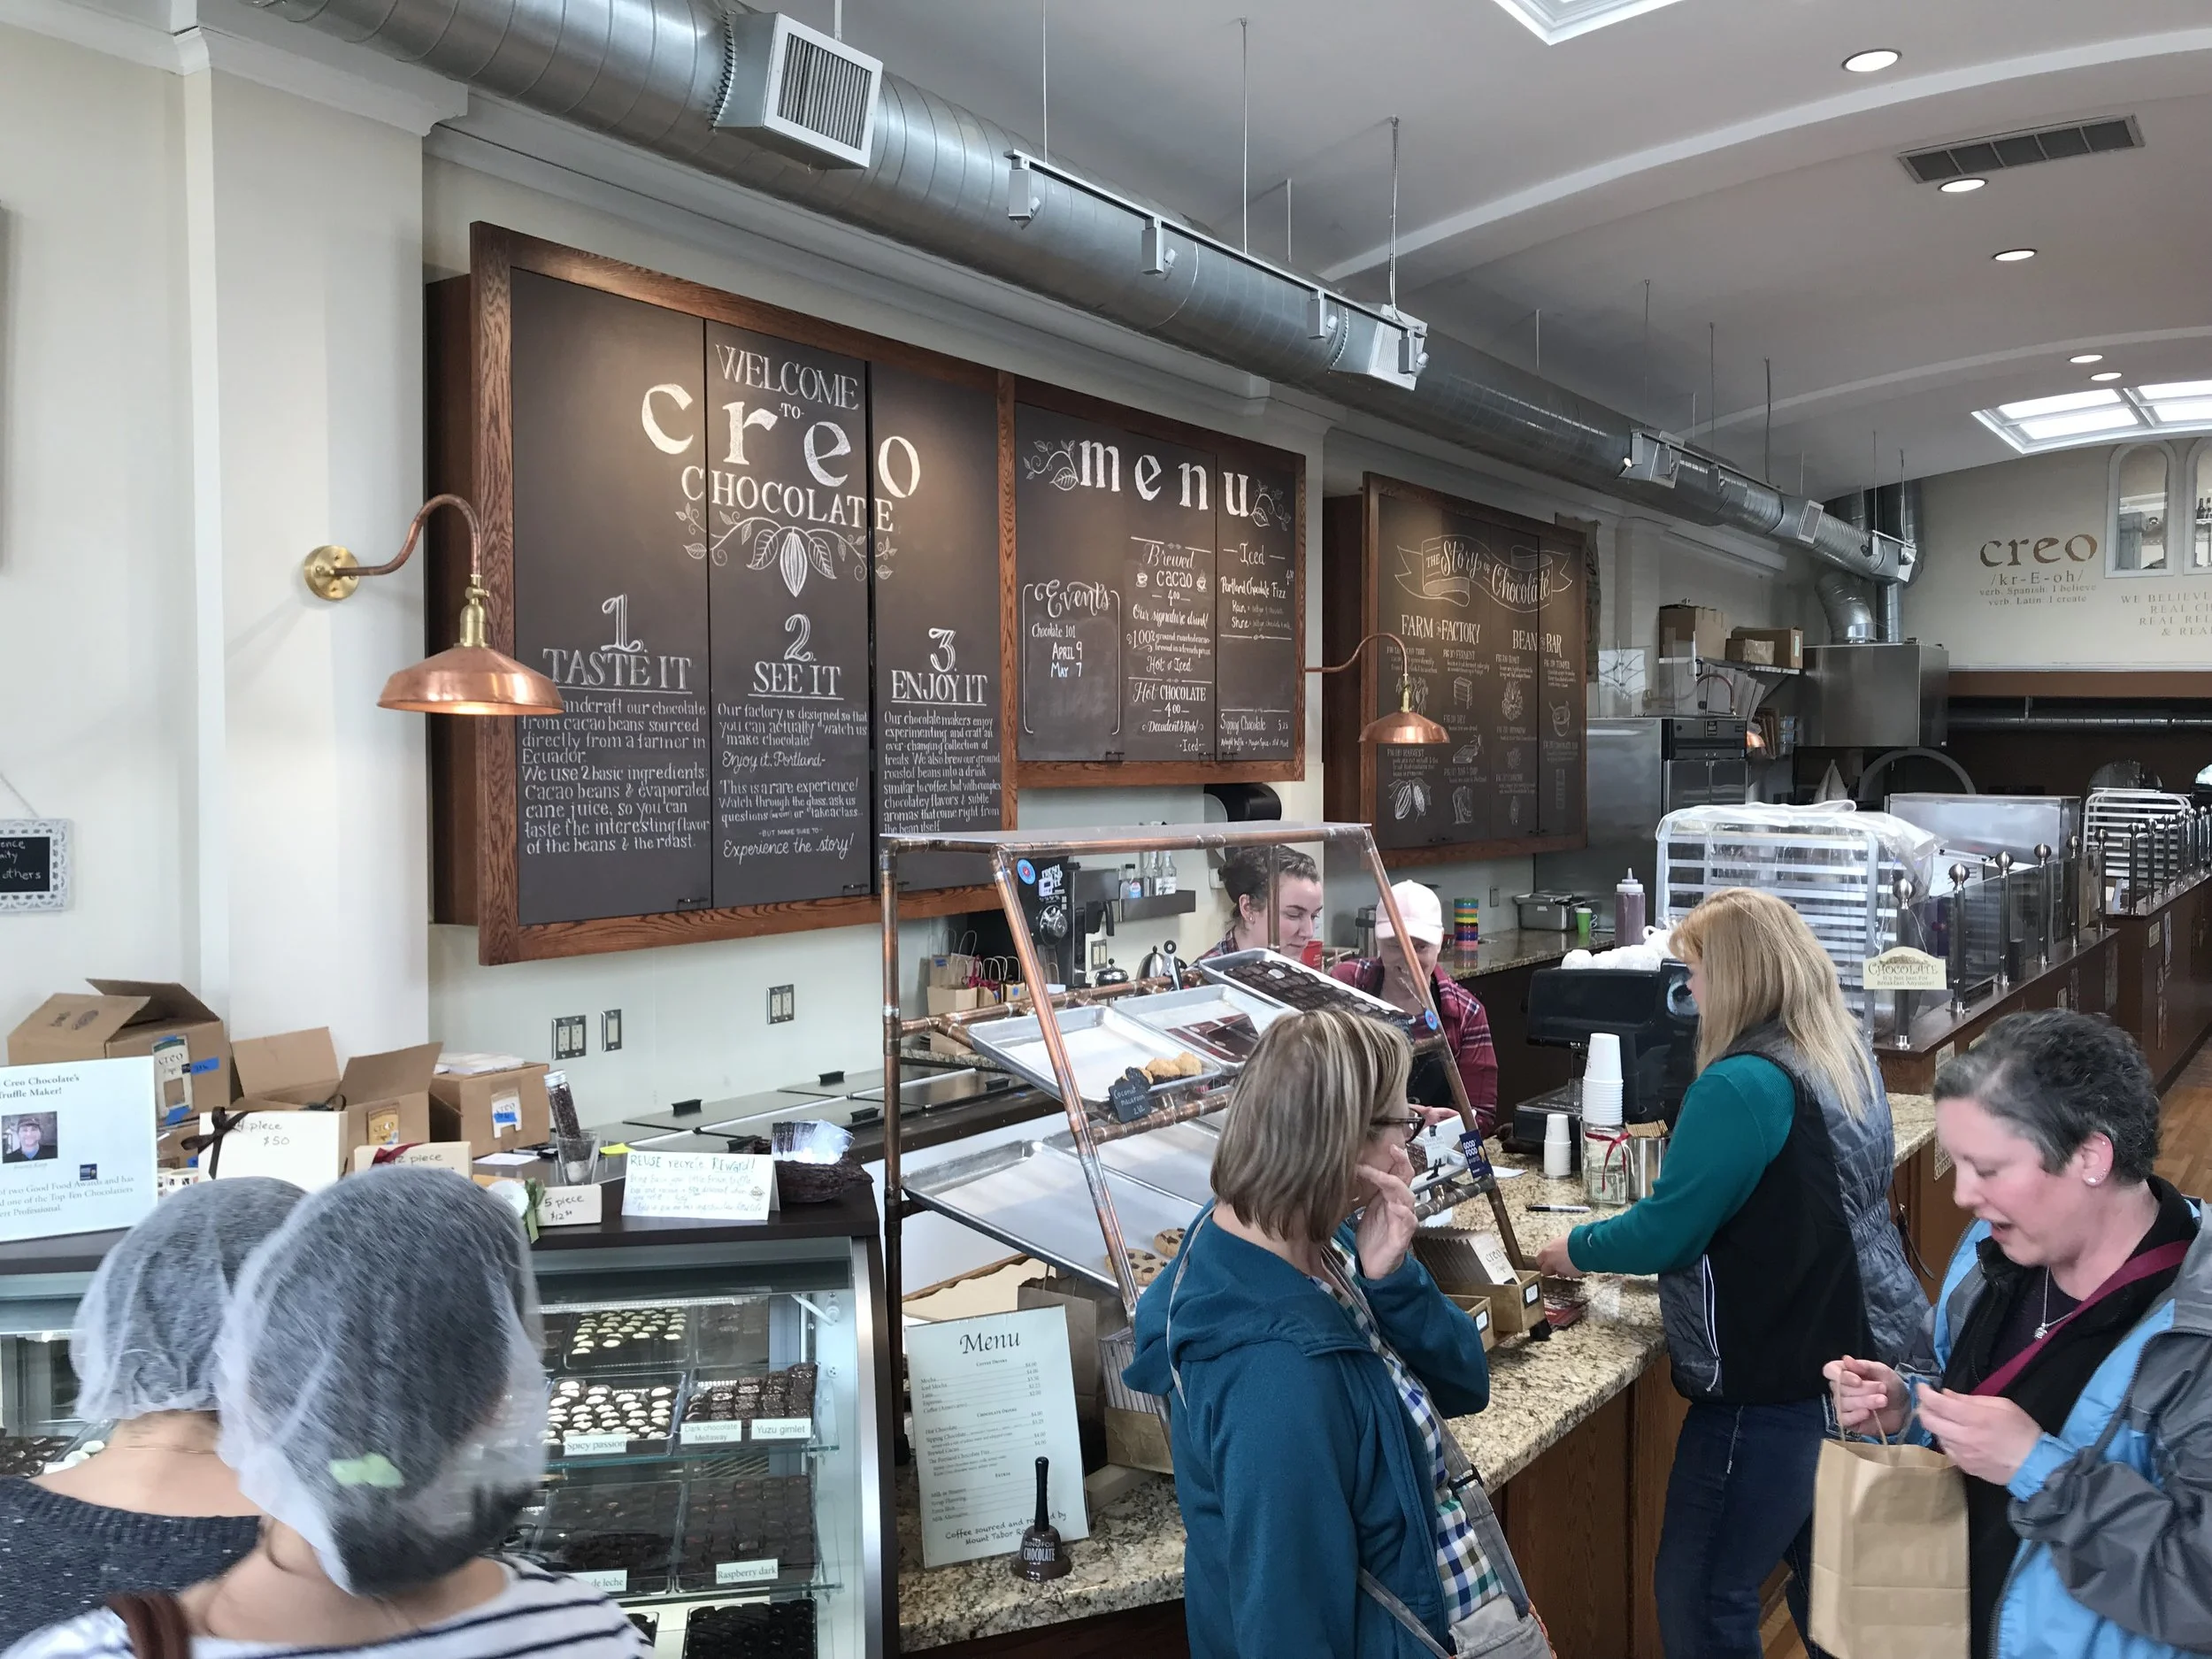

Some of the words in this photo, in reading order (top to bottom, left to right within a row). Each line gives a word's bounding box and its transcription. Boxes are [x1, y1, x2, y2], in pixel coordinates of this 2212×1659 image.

[716, 344, 859, 411] WELCOME
[641, 383, 921, 498] creo
[1079, 440, 1249, 517] menu
[680, 465, 894, 533] CHOCOLATE
[1146, 543, 1195, 570] Brewed
[1239, 541, 1266, 566] Iced
[1979, 534, 2098, 567] creo
[1425, 554, 1440, 569] THE
[1440, 540, 1483, 578] Story
[1491, 563, 1551, 605] Chocolate
[1220, 575, 1247, 595] Portland
[1247, 576, 1270, 598] Chocolate
[2058, 582, 2097, 593] believe
[2056, 594, 2087, 603] create
[1133, 603, 1149, 621] Our
[1150, 609, 1186, 627] signature
[1032, 622, 1064, 638] Chocolate
[1065, 625, 1076, 638] 101
[1401, 613, 1433, 640] FARM
[1441, 618, 1481, 645] FACTORY
[1512, 629, 1538, 652] BEAN
[1546, 632, 1563, 659] BAR
[1076, 641, 1083, 660] 9
[542, 648, 651, 687] TASTE
[657, 656, 693, 689] IT
[1076, 662, 1083, 678] 7
[1146, 656, 1165, 674] Hot
[1174, 657, 1194, 672] Iced
[753, 661, 803, 694] SEE
[810, 664, 841, 695] IT
[891, 670, 960, 702] ENJOY
[964, 675, 988, 703] IT
[1133, 681, 1158, 703] Hot
[1160, 684, 1206, 701] CHOCOLATE
[651, 700, 707, 716] chocolate
[718, 703, 742, 717] Our
[745, 703, 783, 724] factory
[798, 707, 840, 727] designed
[521, 715, 560, 731] from
[564, 718, 605, 731] cacao
[608, 716, 644, 732] beans
[649, 718, 700, 733] sourced
[769, 721, 814, 740] actually
[1220, 712, 1239, 735] Sipping
[1240, 715, 1266, 731] Chocolate
[521, 732, 580, 749] directly
[586, 732, 622, 749] from
[637, 733, 689, 749] farmer
[726, 734, 759, 747] make
[885, 726, 948, 742] experimenting
[722, 750, 758, 774] Enjoy
[521, 765, 547, 782] We
[550, 767, 579, 781] use
[592, 764, 624, 780] basic
[525, 784, 574, 801] Cacao
[577, 783, 620, 797] beans
[638, 780, 710, 803] evaporated
[719, 780, 747, 795] This
[526, 803, 565, 818] cane
[524, 819, 562, 839] taste
[565, 818, 590, 837] the
[595, 818, 675, 839] interesting
[526, 839, 541, 855] of
[546, 839, 571, 853] the
[574, 837, 617, 853] beans
[621, 837, 629, 851] &
[634, 836, 655, 850] the
[723, 840, 790, 865] Experience
[794, 837, 812, 853] the
[2, 867, 42, 880] others
[1868, 961, 1939, 977] CHOCOLATE
[158, 1053, 183, 1066] creo
[4, 1079, 25, 1087] Creo
[28, 1073, 80, 1086] Chocolate's
[30, 1087, 62, 1096] Maker!
[250, 1120, 282, 1133] piece
[264, 1135, 290, 1147] $50
[1463, 1140, 1476, 1150] GOOD
[410, 1153, 443, 1164] piece
[1465, 1147, 1479, 1157] FOOD
[630, 1154, 662, 1168] REUSE
[26, 1184, 49, 1194] Good
[51, 1181, 72, 1190] Food
[73, 1179, 103, 1188] Awards
[104, 1176, 119, 1185] and
[35, 1194, 48, 1203] the
[50, 1193, 65, 1203] Top
[544, 1197, 553, 1209] 5
[555, 1194, 585, 1207] piece
[1485, 1248, 1502, 1263] creo
[959, 1331, 1021, 1355] Menu
[703, 1423, 739, 1432] chocolate
[757, 1425, 778, 1434] Yuzu
[780, 1425, 806, 1435] gimlet
[566, 1439, 590, 1451] Spicy
[592, 1438, 626, 1451] passion
[945, 1528, 972, 1540] Coffee
[975, 1522, 1006, 1534] sourced
[1008, 1517, 1024, 1528] and
[1056, 1509, 1067, 1522] by
[965, 1535, 990, 1547] Mount
[992, 1530, 1014, 1540] Tabor
[1023, 1548, 1056, 1562] CHOCOLATE
[591, 1578, 600, 1588] de
[601, 1576, 624, 1587] leche
[717, 1568, 757, 1583] Raspberry
[757, 1566, 778, 1577] dark
